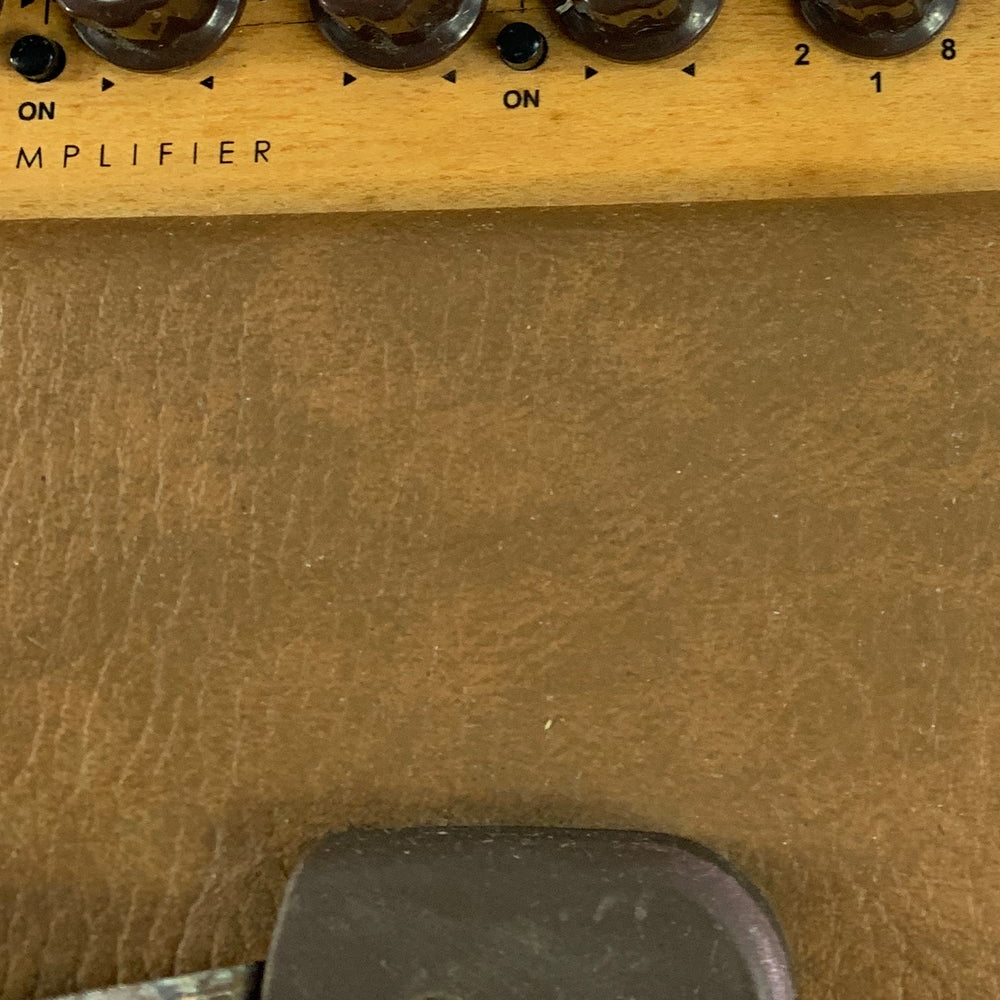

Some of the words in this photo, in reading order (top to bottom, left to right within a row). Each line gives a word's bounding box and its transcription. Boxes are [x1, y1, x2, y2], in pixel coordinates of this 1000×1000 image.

[795, 44, 810, 65] 2
[942, 40, 955, 60] 8
[870, 72, 881, 92] 1
[504, 90, 539, 108] ON
[19, 102, 54, 120] ON
